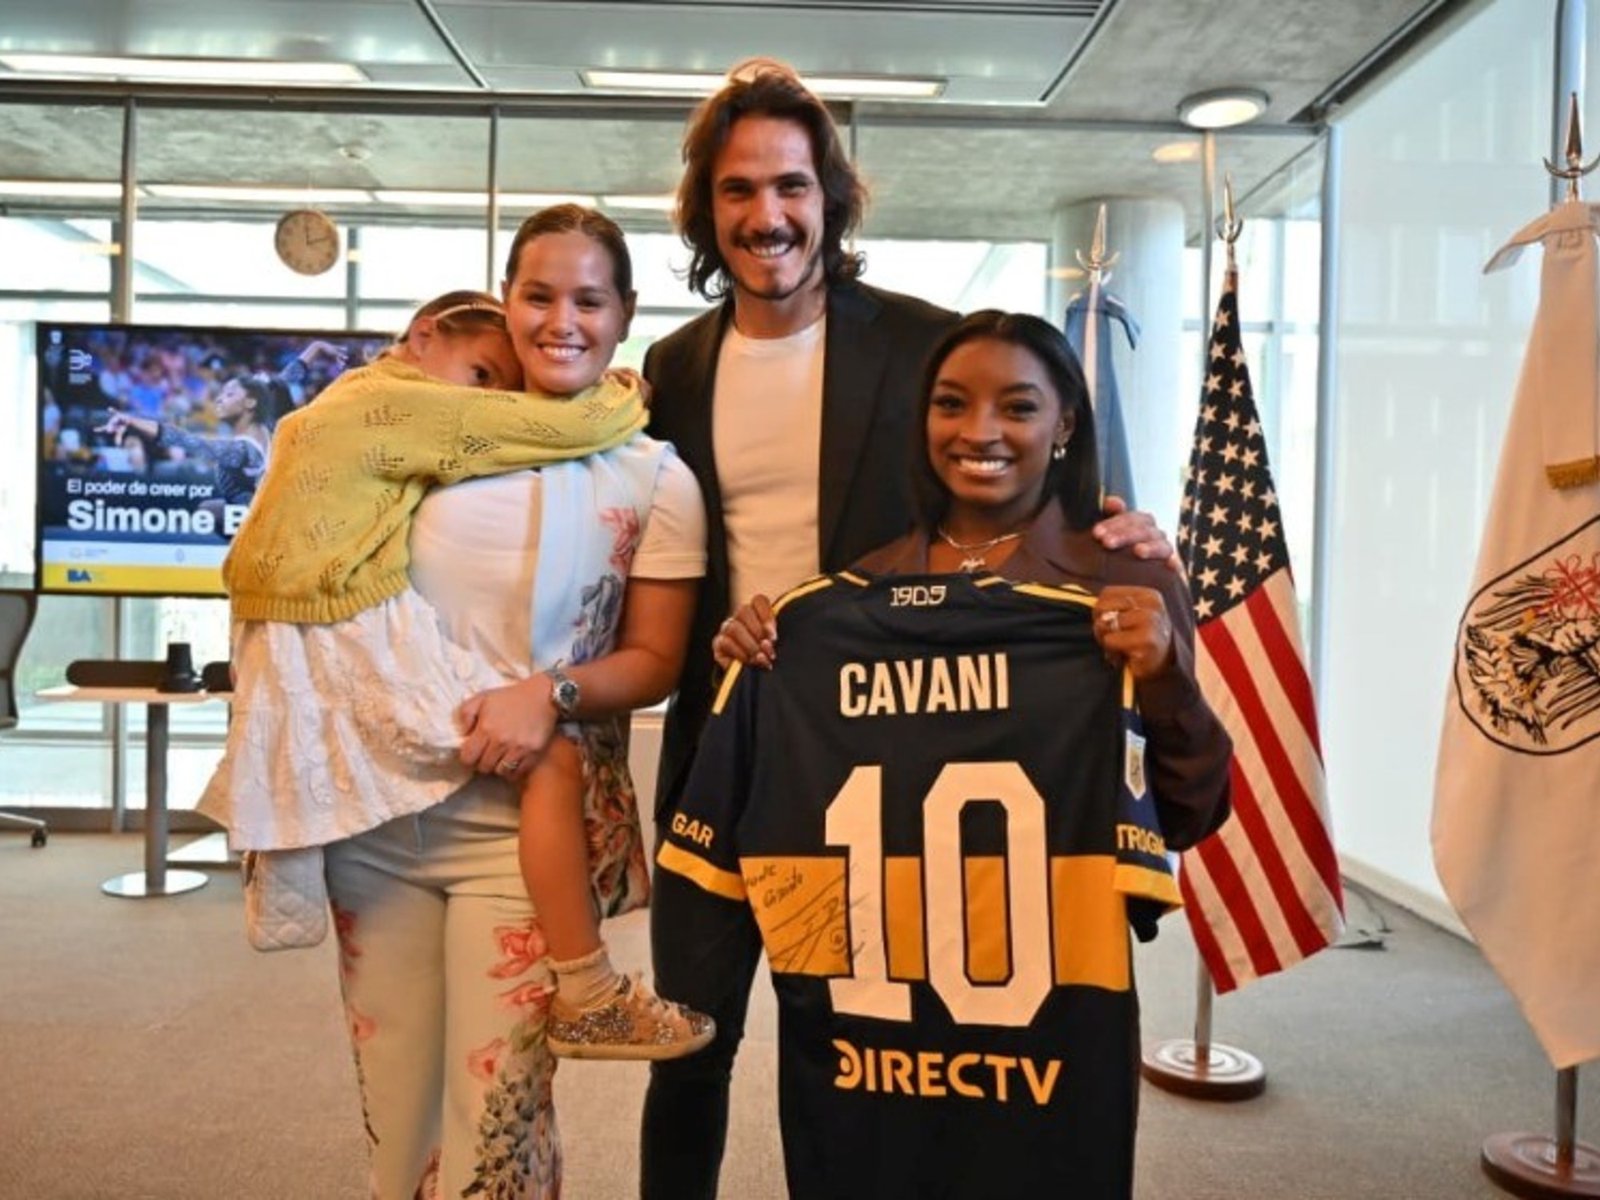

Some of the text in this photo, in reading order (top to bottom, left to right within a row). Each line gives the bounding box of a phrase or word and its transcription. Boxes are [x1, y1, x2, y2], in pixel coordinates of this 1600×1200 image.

[67, 479, 214, 499] El poder de creer por
[67, 499, 215, 535] Simone
[839, 653, 1008, 717] CAVANI
[672, 812, 713, 849] GAR
[825, 761, 1053, 1027] 10
[832, 1039, 1062, 1104] DIRECTV
